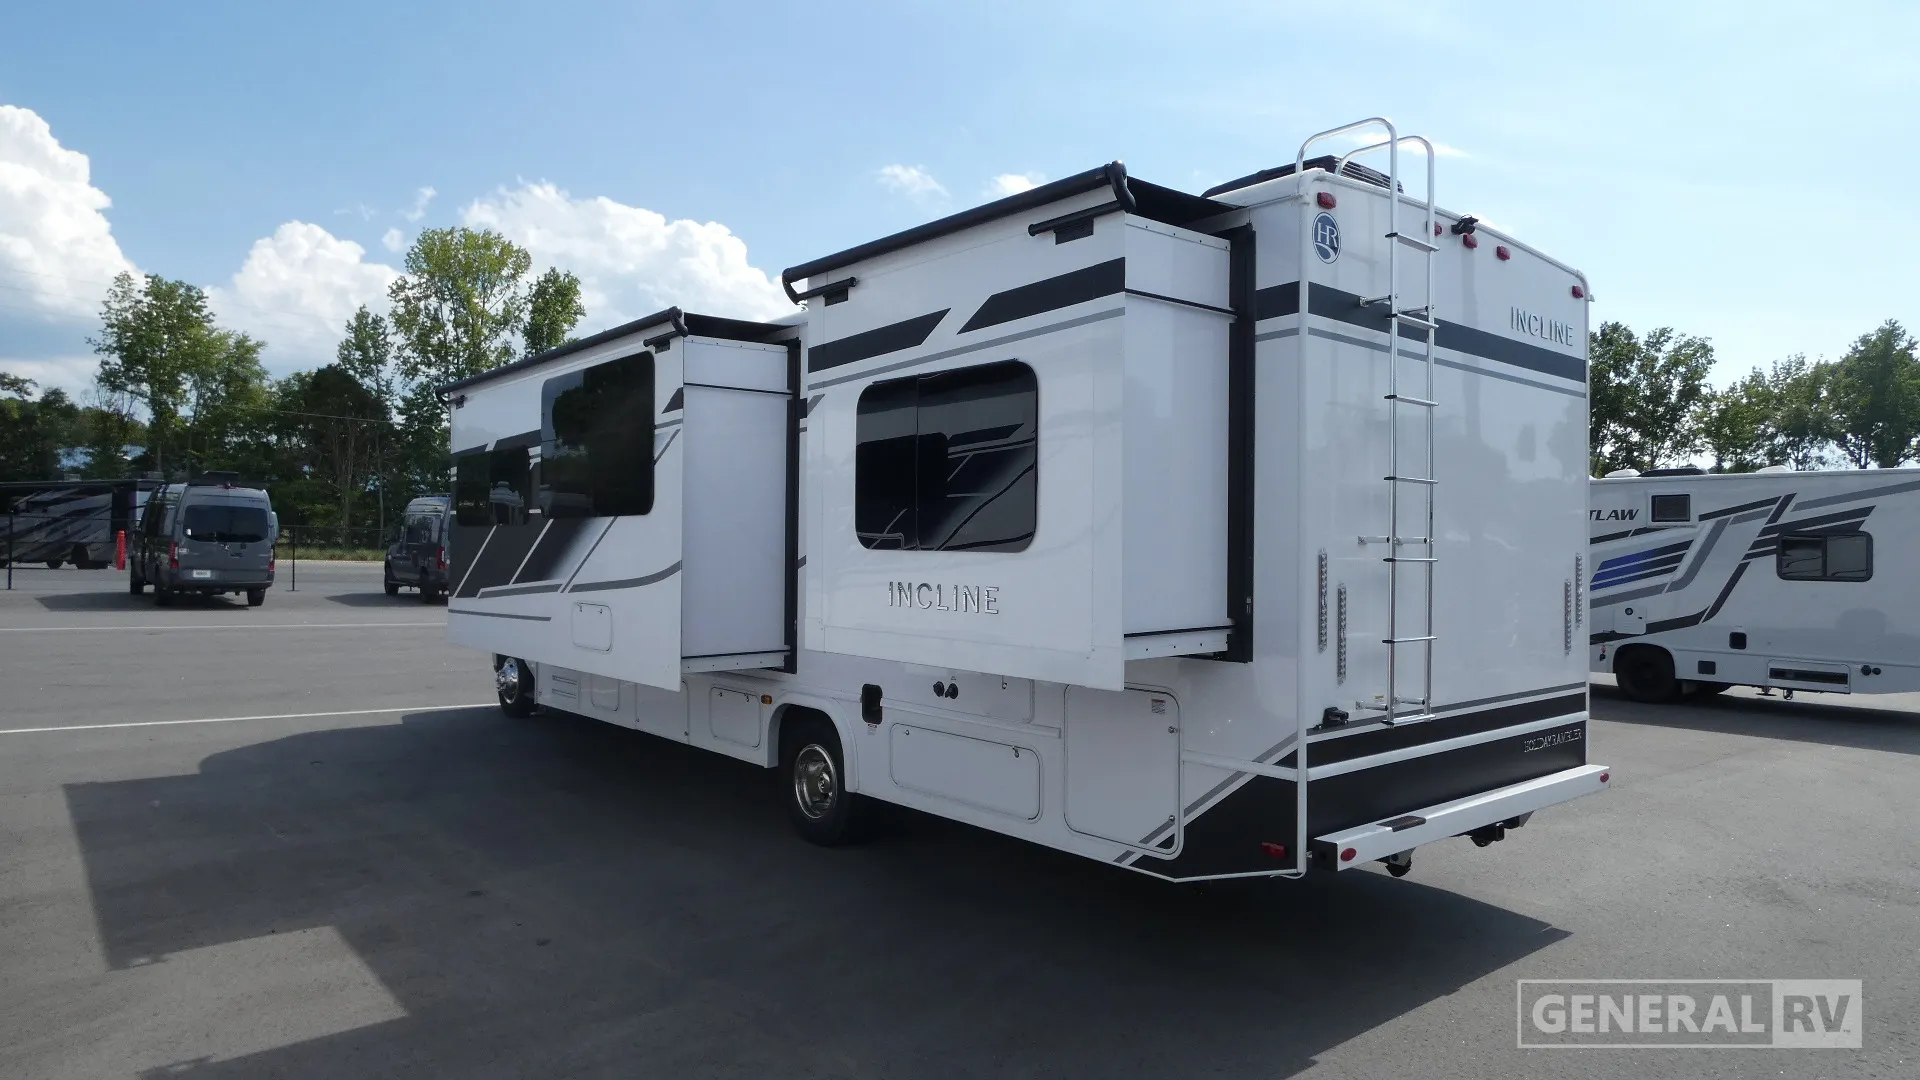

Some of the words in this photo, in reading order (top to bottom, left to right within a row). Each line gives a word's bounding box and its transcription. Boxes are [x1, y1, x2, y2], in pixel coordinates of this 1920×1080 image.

[1317, 222, 1338, 248] HR
[1511, 306, 1574, 347] INCLINE
[1589, 509, 1639, 521] TLAW
[888, 581, 1000, 615] INCLINE
